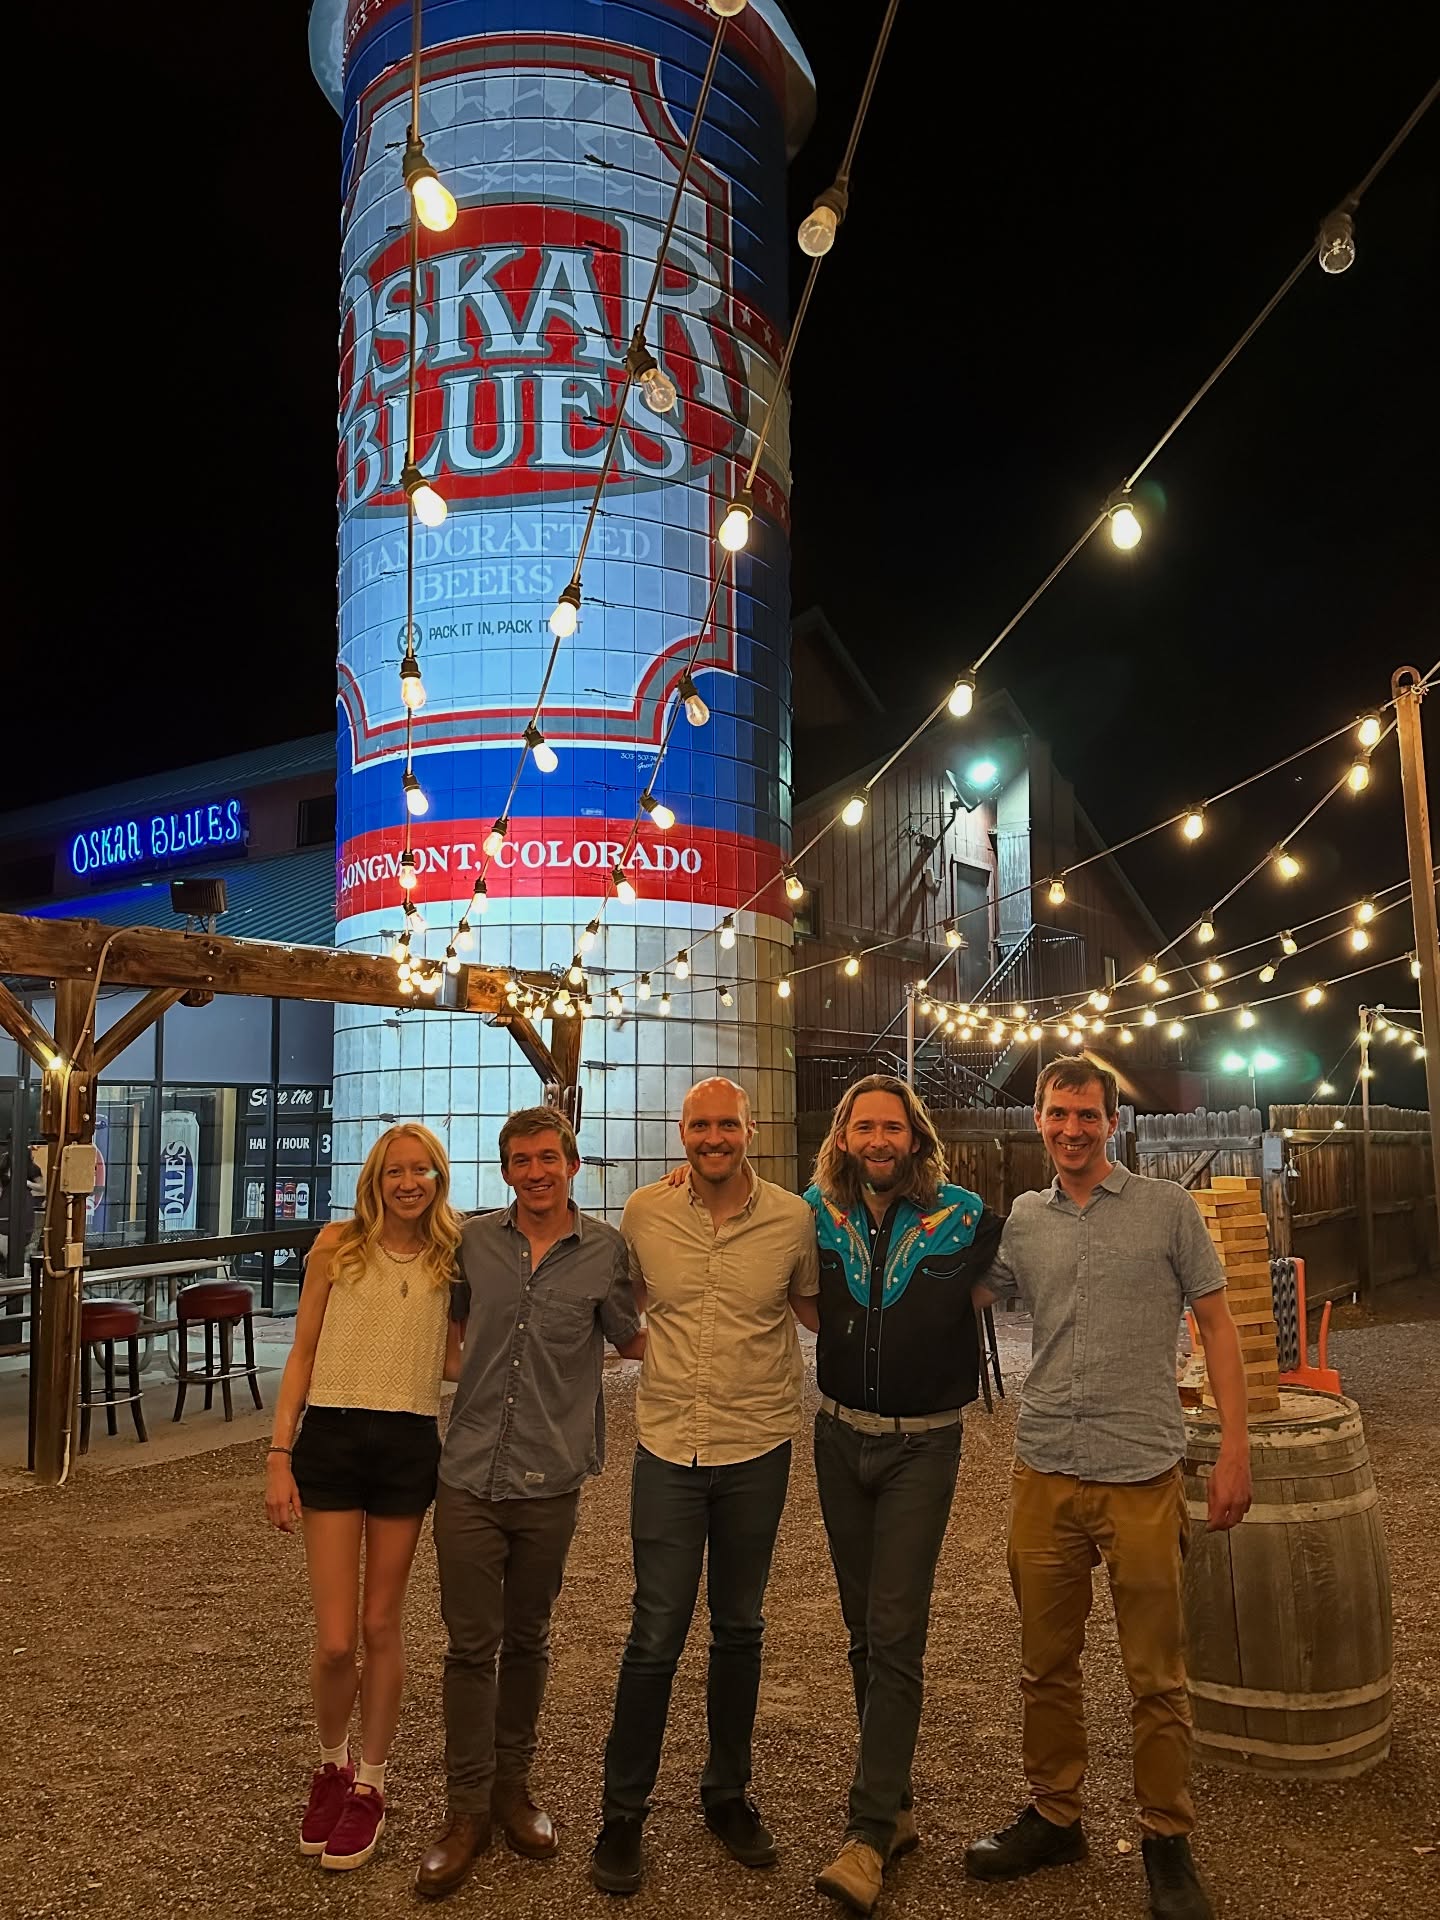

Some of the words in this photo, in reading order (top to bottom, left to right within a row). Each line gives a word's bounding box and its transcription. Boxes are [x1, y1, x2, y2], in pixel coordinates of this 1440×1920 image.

[341, 215, 732, 424] OSKAR
[344, 369, 686, 508] BLUES
[358, 521, 650, 586] HANDCRAFTED
[415, 564, 553, 605] BEERS
[429, 624, 458, 641] PACK
[462, 622, 473, 637] IT
[478, 621, 495, 637] IN,
[497, 619, 533, 634] PACK
[539, 619, 550, 633] IT
[72, 821, 141, 873] OSKAR
[151, 800, 239, 855] BLUES
[340, 843, 481, 893] LONGMONT,
[493, 839, 702, 874] COLORADO
[290, 1089, 313, 1105] the
[282, 1137, 310, 1150] HOUR
[163, 1140, 187, 1220] DALE'S
